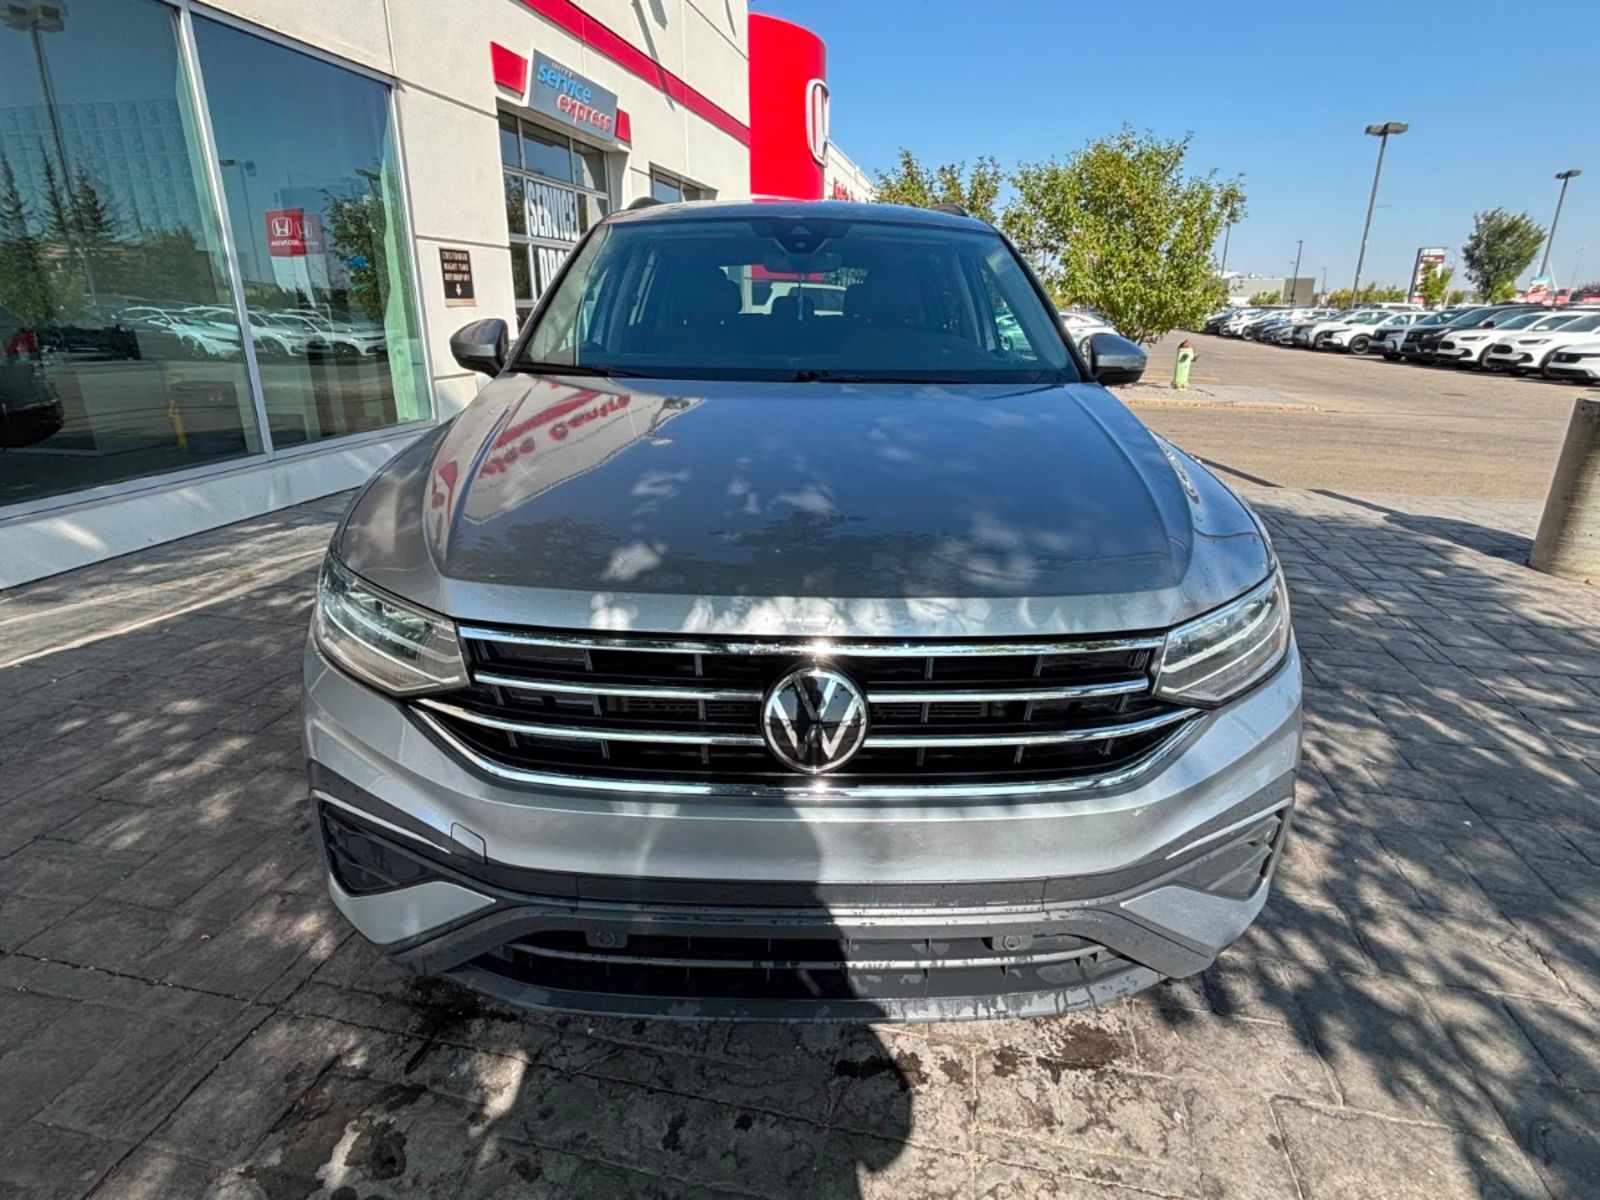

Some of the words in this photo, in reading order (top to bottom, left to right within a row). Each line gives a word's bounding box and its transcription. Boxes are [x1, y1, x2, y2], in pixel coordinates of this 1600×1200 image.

[537, 63, 592, 104] service
[556, 93, 612, 132] express
[527, 180, 577, 242] SERVICE
